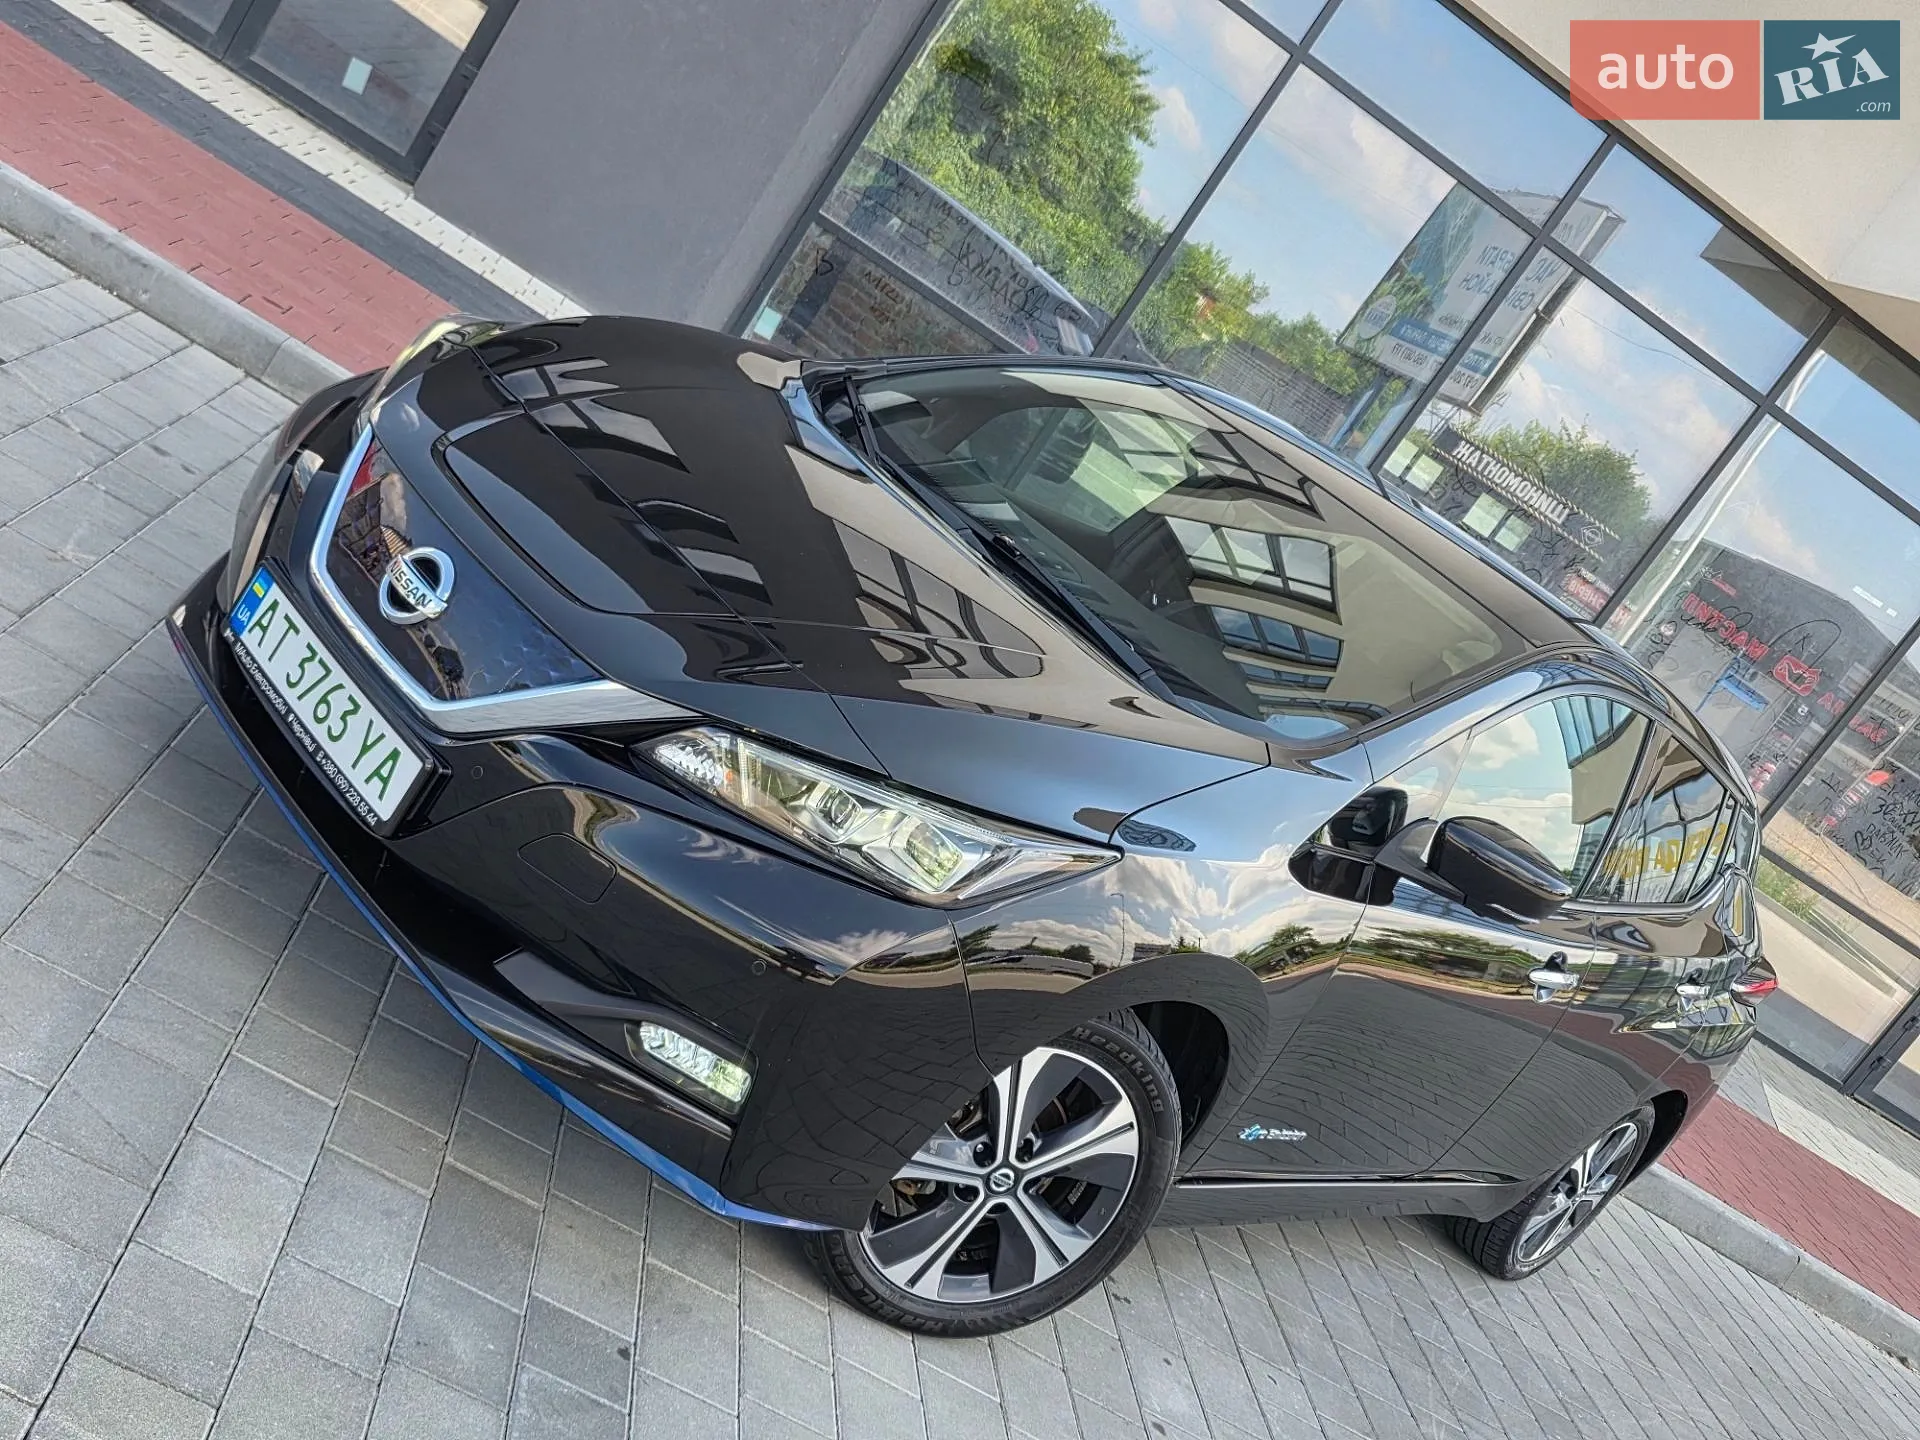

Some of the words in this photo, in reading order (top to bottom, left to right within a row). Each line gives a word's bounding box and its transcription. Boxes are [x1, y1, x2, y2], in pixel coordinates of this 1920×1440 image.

[389, 562, 432, 609] NISSAN
[237, 604, 251, 626] UA
[248, 599, 300, 662] AT
[286, 642, 362, 742] 3763
[351, 719, 402, 801] YA
